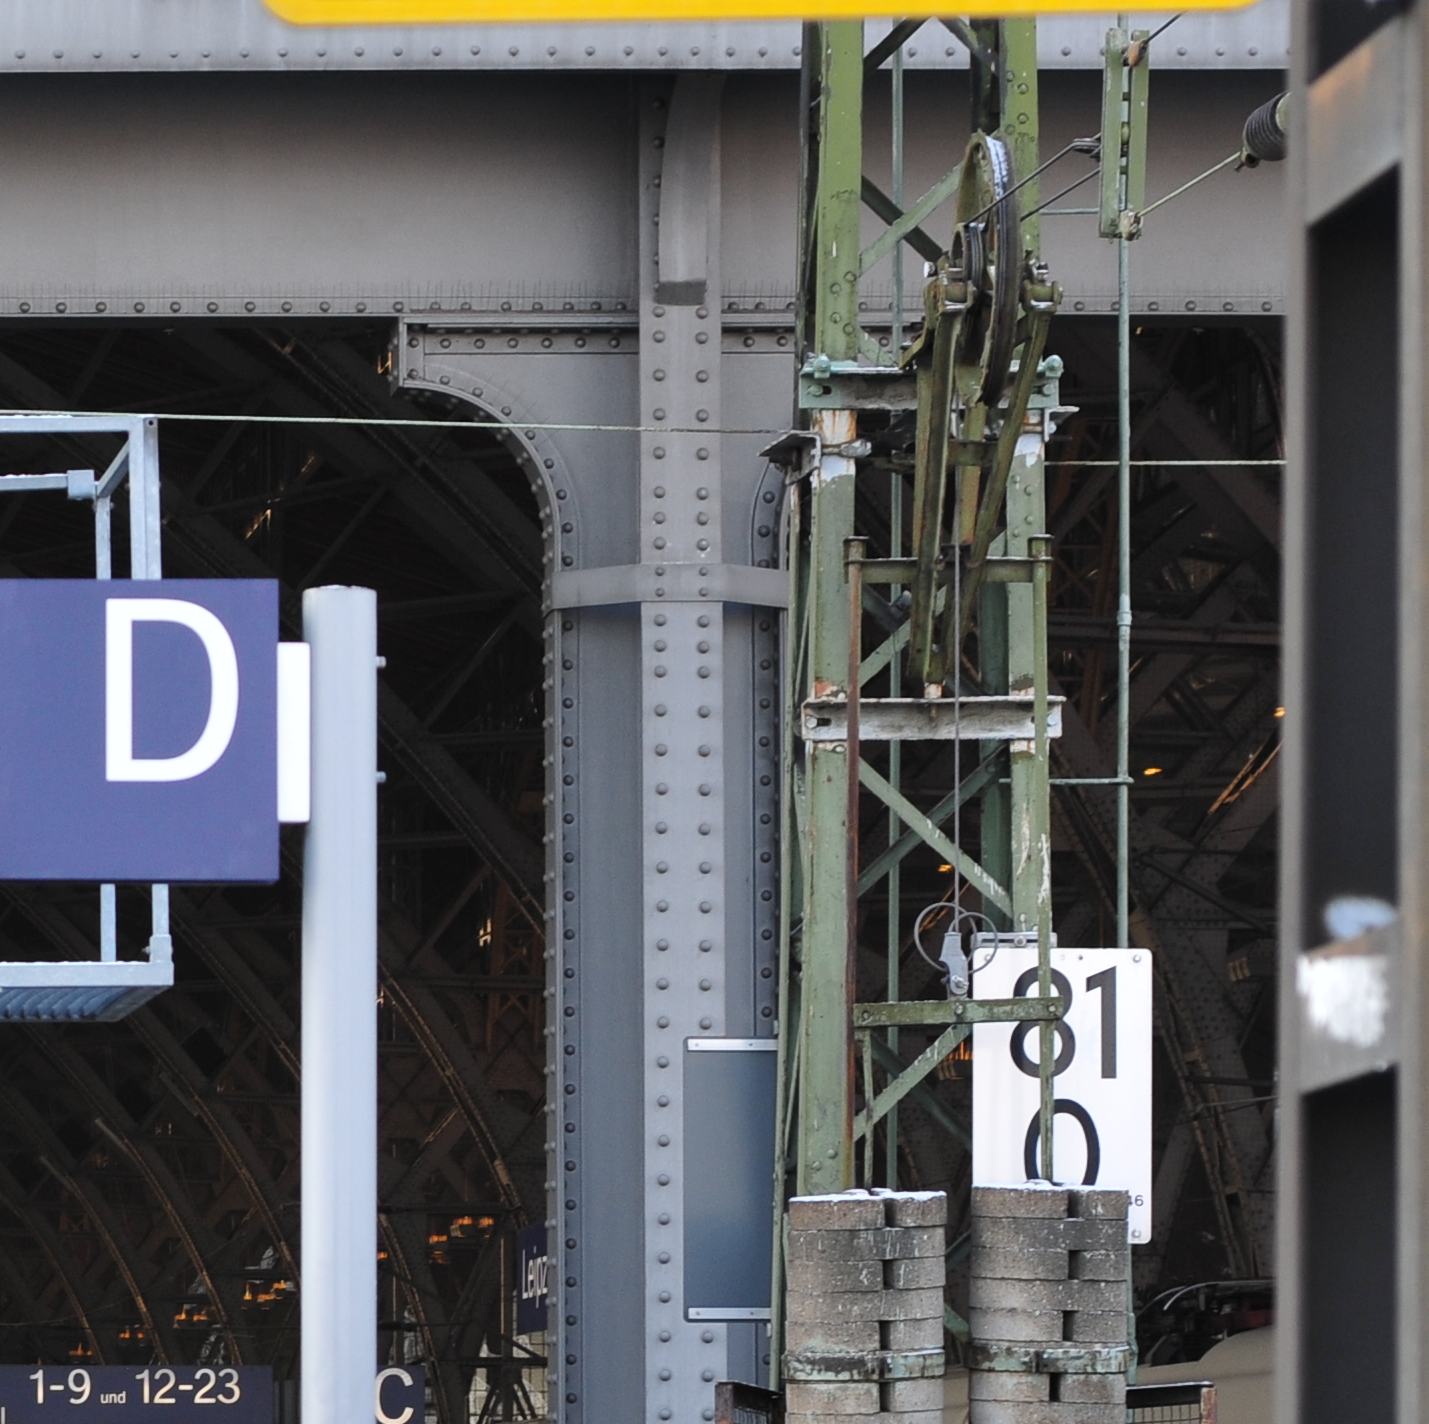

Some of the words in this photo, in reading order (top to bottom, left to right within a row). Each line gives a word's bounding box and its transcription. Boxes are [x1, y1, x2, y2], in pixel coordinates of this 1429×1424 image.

[106, 598, 240, 782] D
[1010, 965, 1117, 1079] 81
[29, 1368, 91, 1404] 1-9
[100, 1391, 126, 1404] und
[135, 1368, 241, 1404] 12-23
